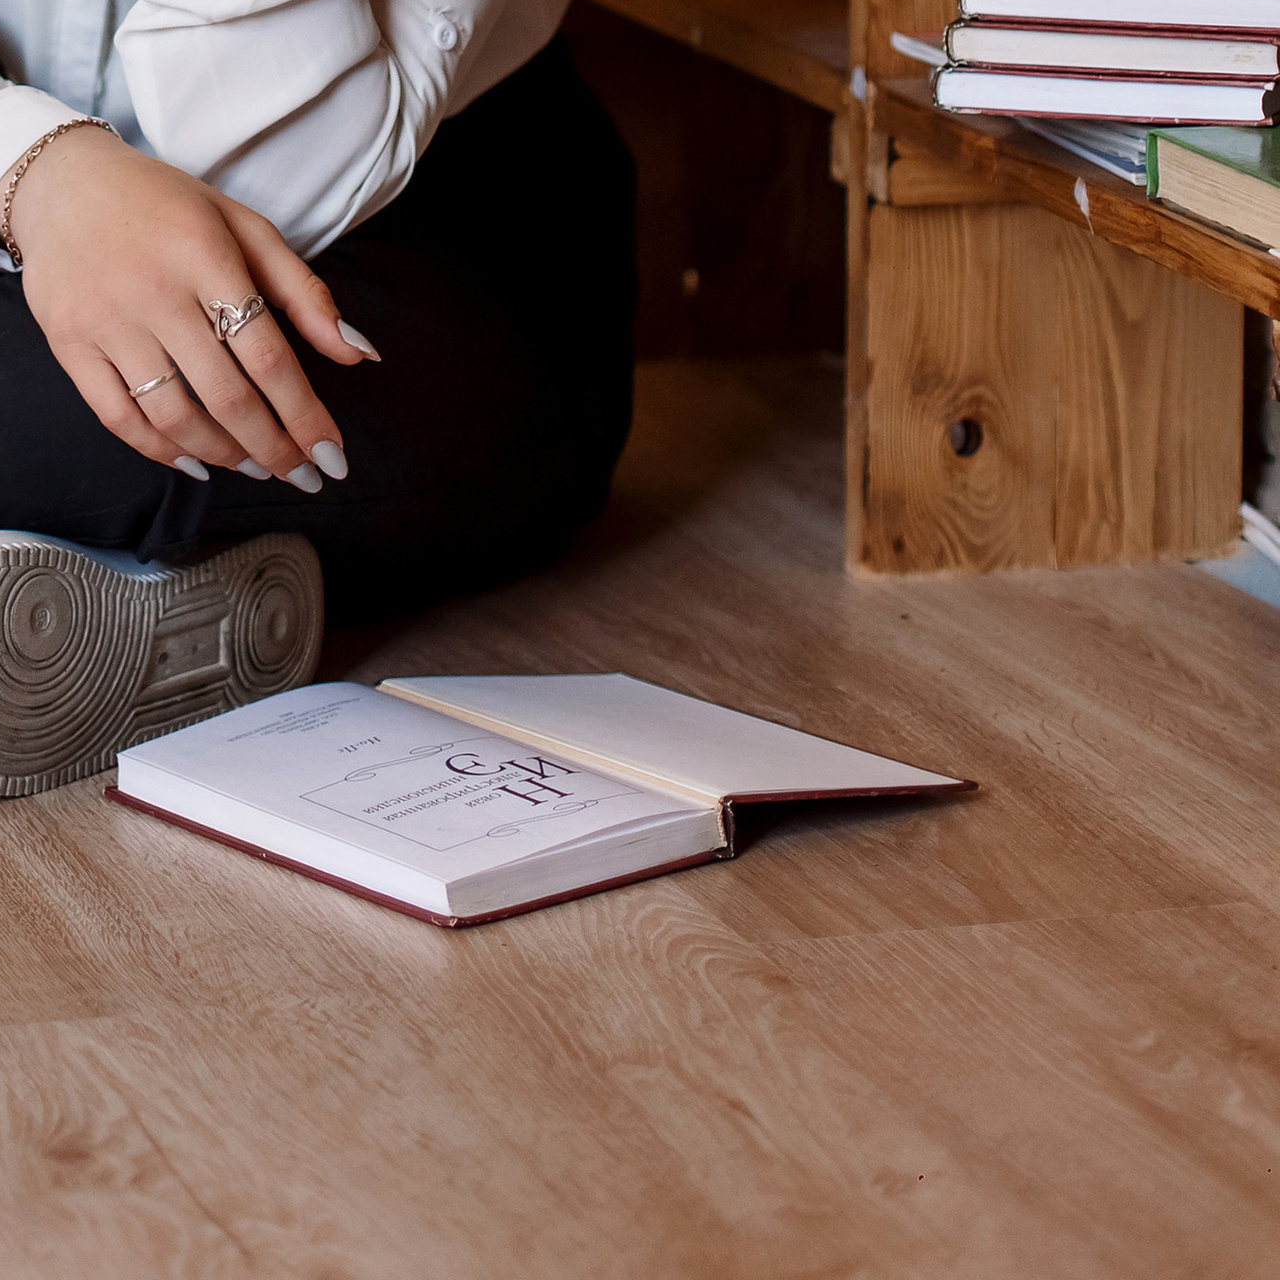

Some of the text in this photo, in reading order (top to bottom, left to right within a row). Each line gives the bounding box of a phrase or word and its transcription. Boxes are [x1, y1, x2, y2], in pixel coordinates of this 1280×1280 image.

[361, 752, 507, 816] Энциклопедия
[381, 757, 582, 824] Иллюстрированная
[463, 777, 575, 809] Новая
